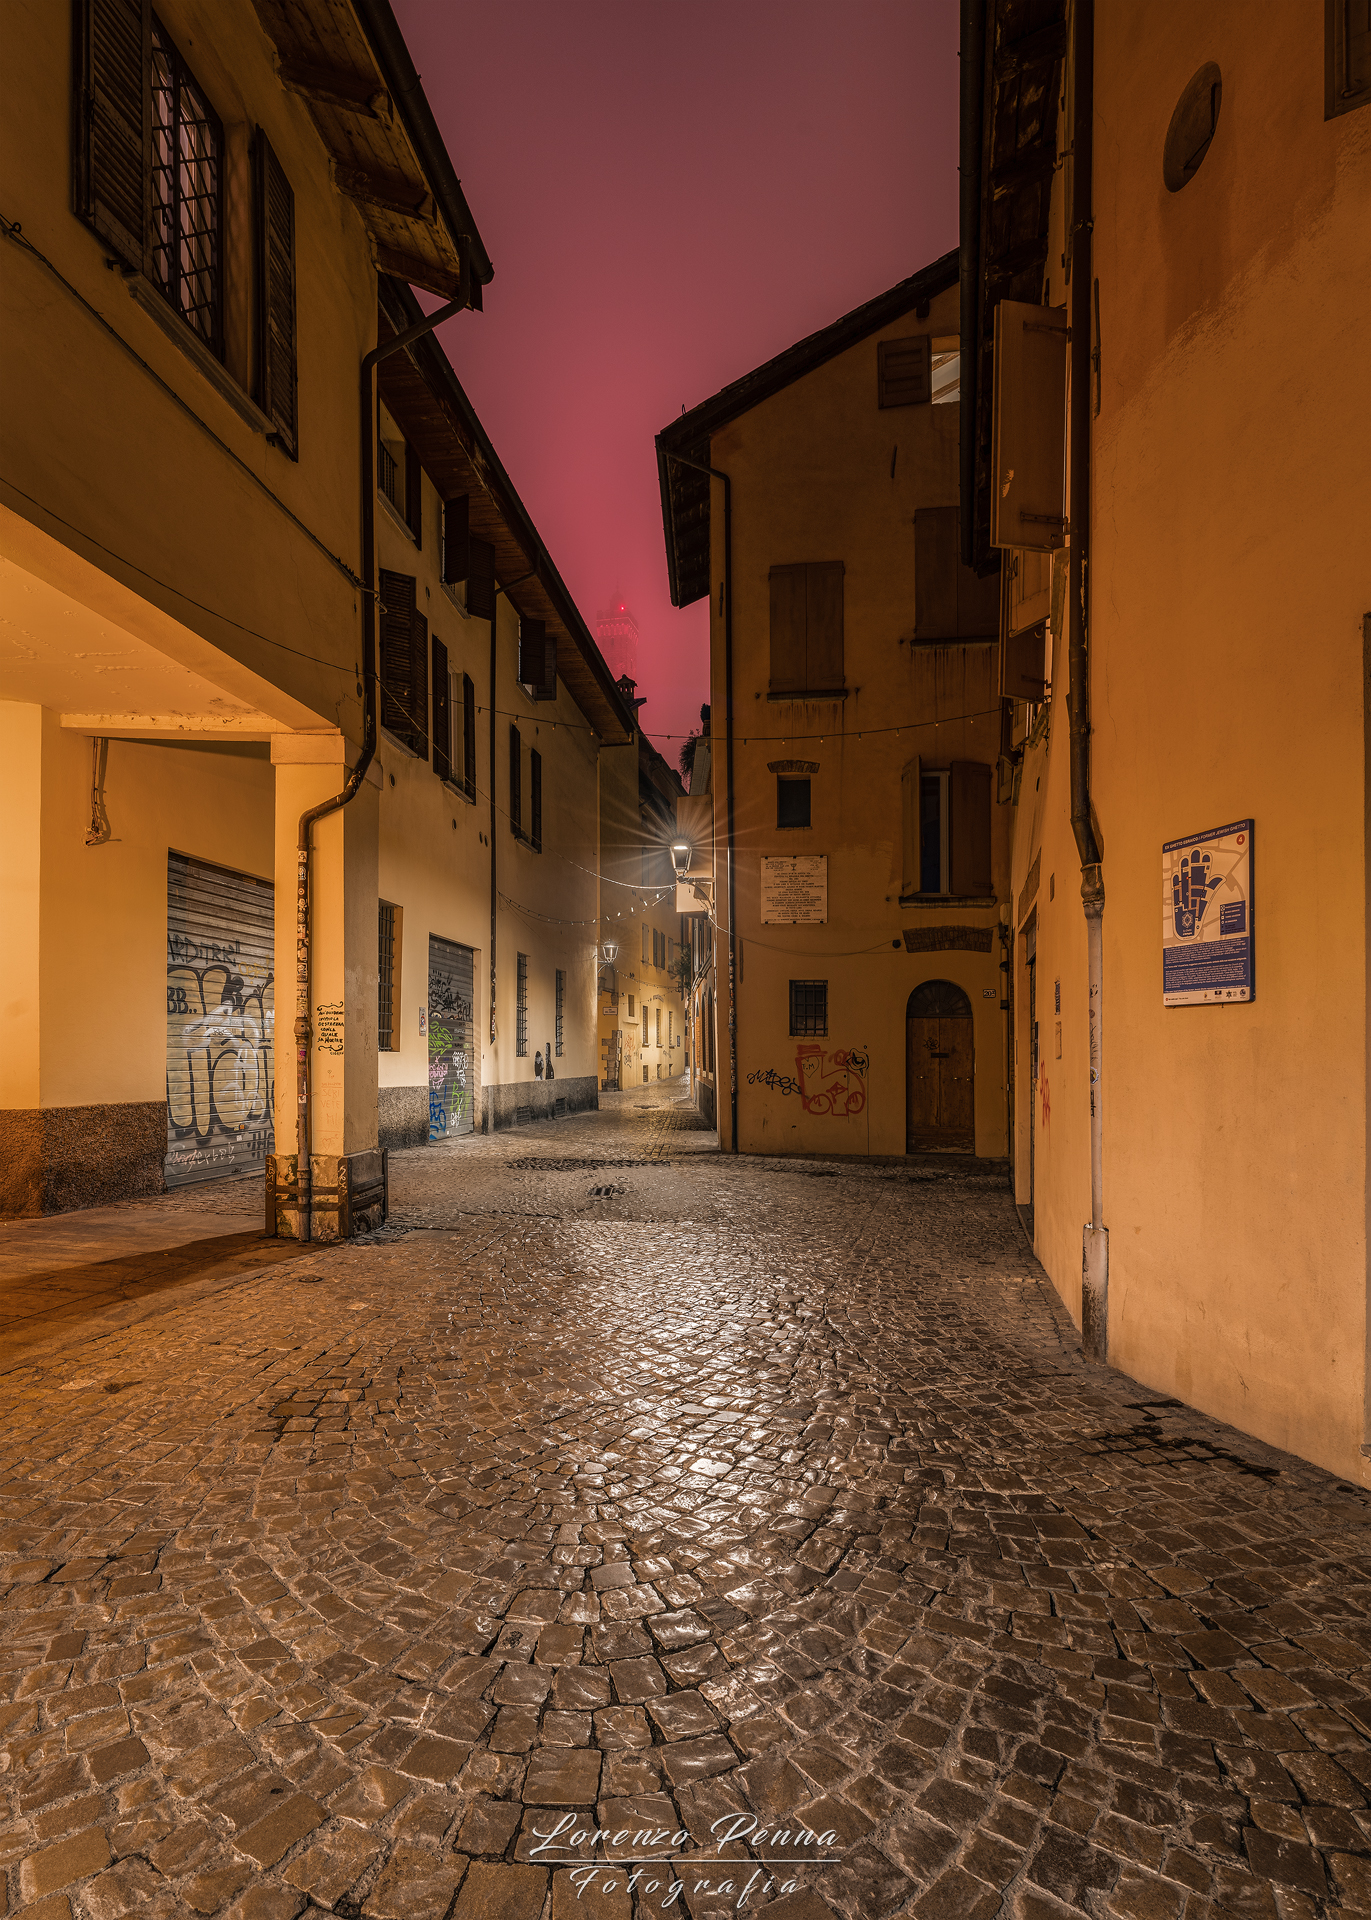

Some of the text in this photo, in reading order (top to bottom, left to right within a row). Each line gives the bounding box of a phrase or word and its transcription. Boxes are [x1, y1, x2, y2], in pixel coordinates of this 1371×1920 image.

[1169, 841, 1183, 850] GHETTO
[1200, 831, 1216, 840] FORMER
[1215, 828, 1230, 836] JEWISH
[1229, 822, 1246, 832] GHETTO
